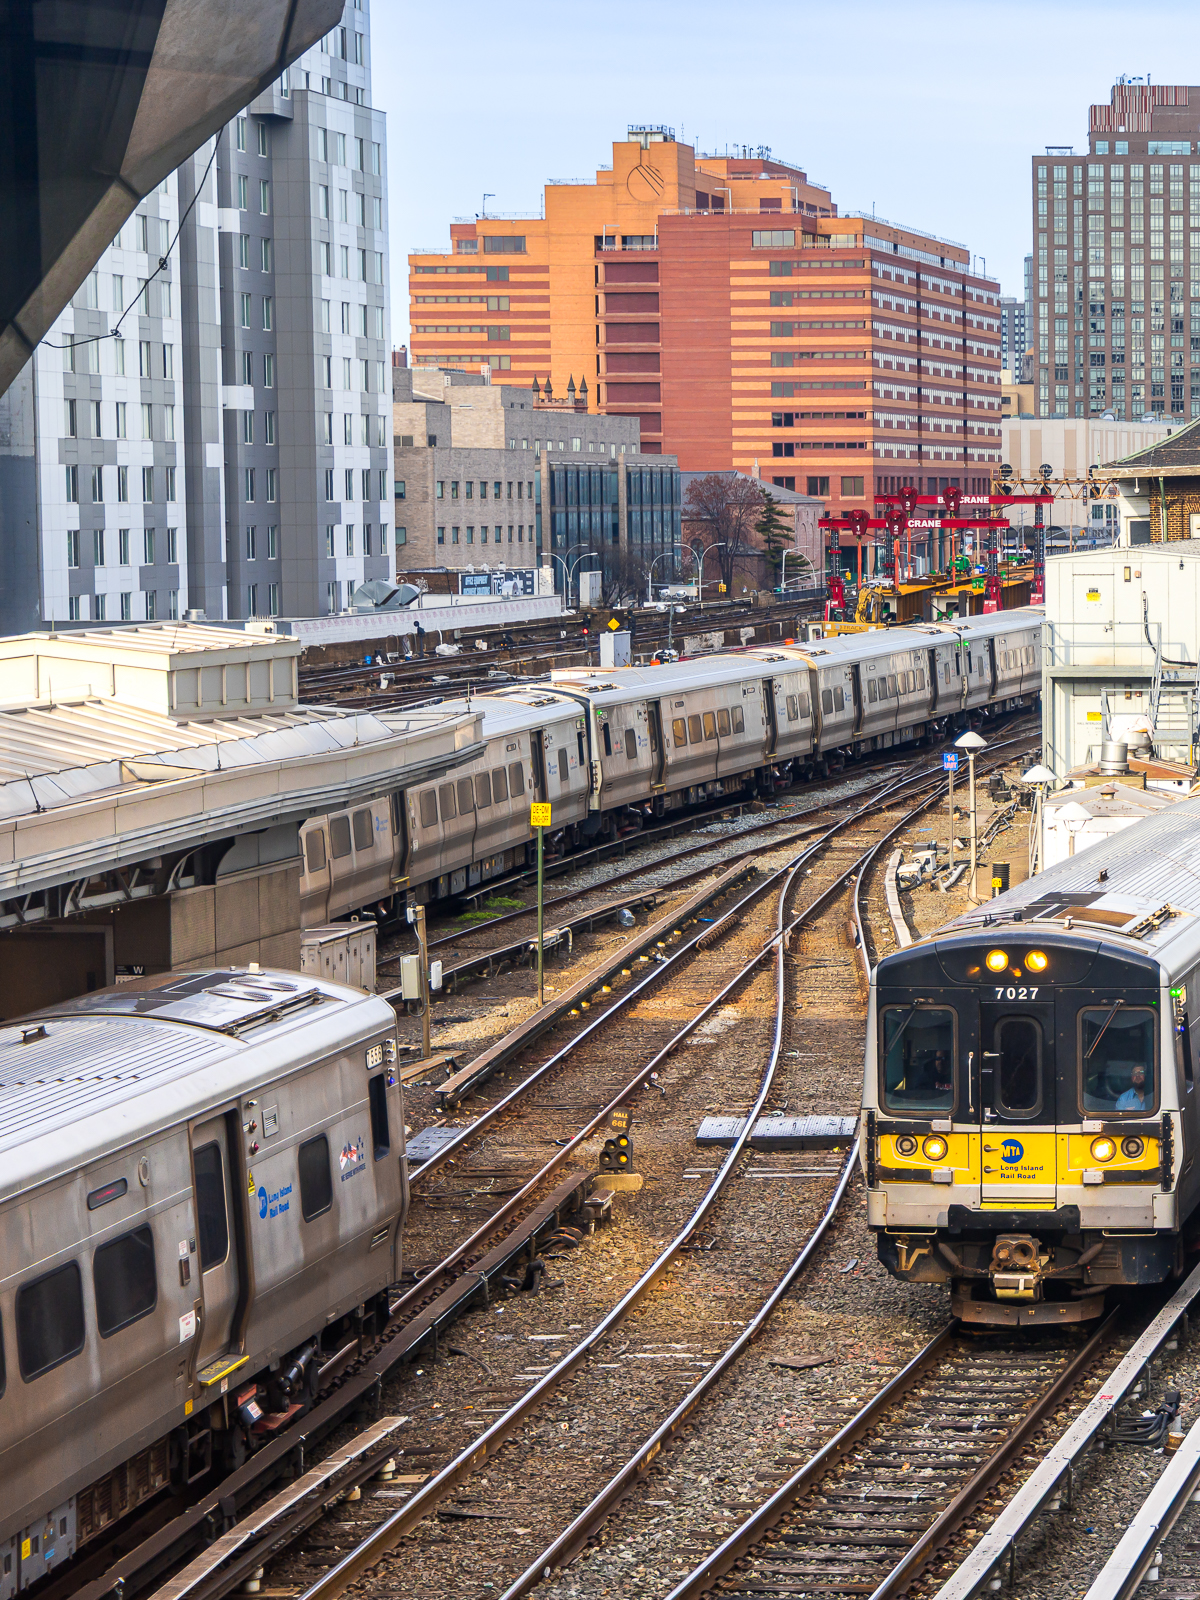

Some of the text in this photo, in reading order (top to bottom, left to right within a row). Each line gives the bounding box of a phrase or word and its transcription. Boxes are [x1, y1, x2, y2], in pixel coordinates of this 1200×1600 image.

[907, 519, 942, 528] CRANE
[133, 966, 144, 974] W
[995, 987, 1039, 1000] 7027
[613, 1111, 629, 1119] HALL
[611, 1119, 628, 1128] 66L
[268, 1183, 292, 1203] Long Island
[269, 1200, 290, 1218] Rail Road
